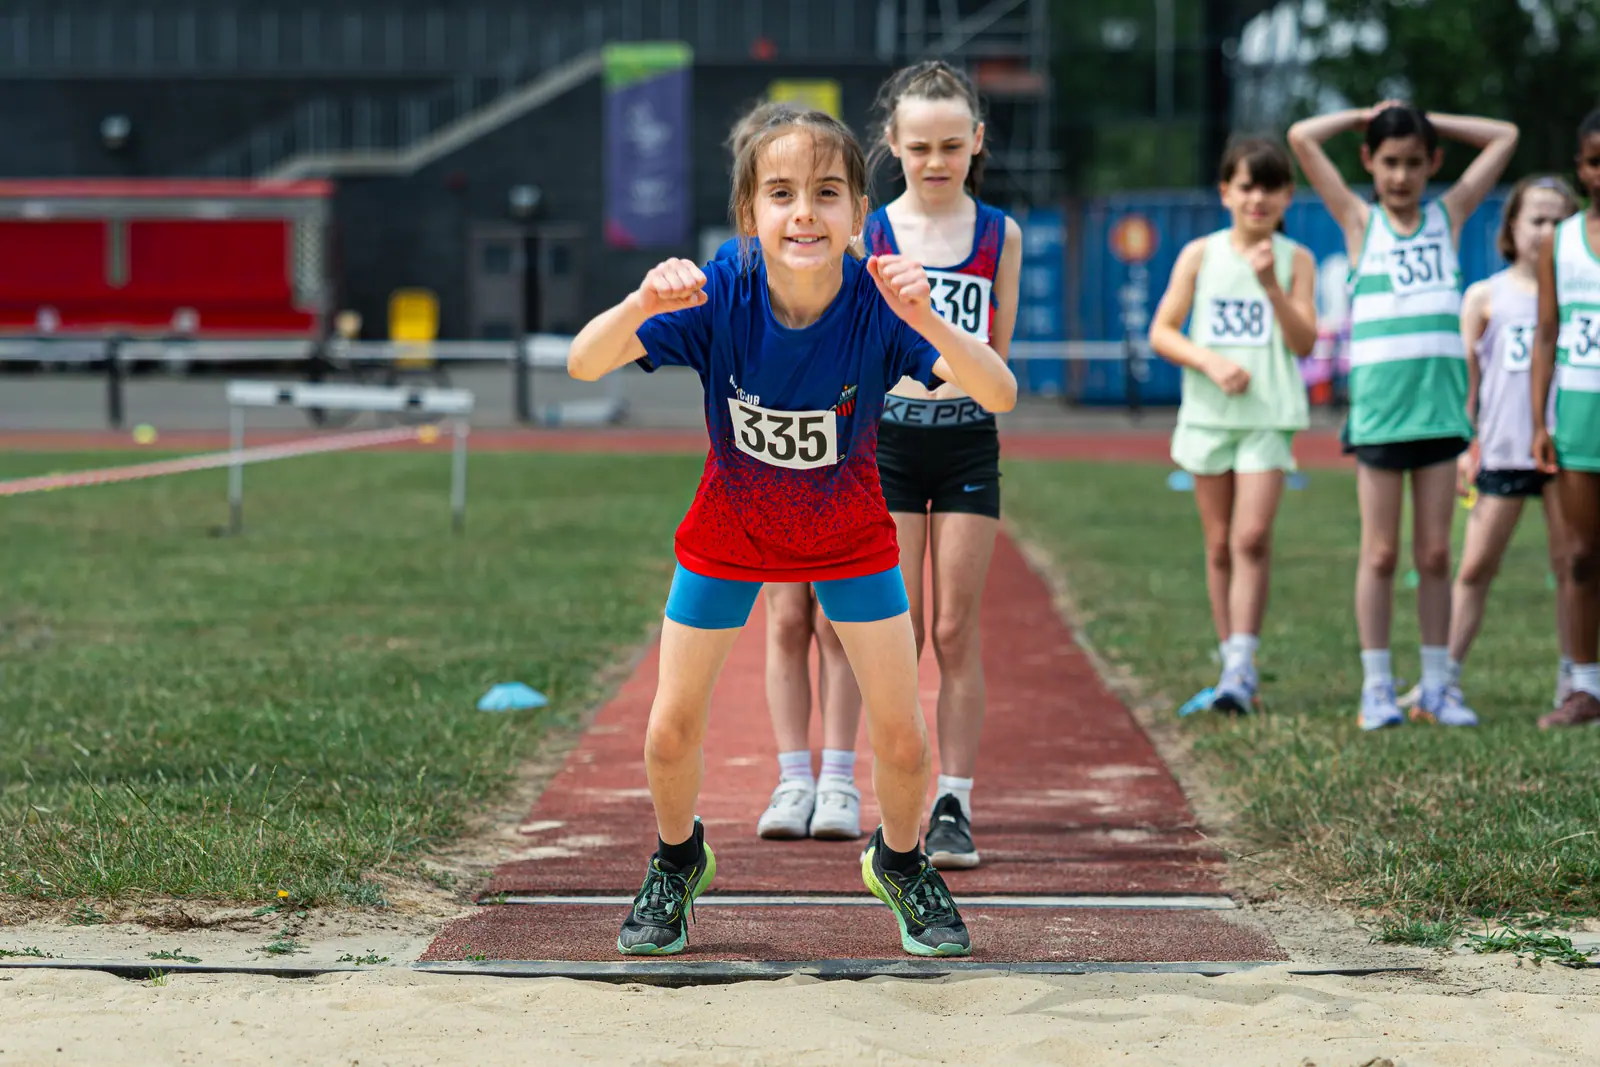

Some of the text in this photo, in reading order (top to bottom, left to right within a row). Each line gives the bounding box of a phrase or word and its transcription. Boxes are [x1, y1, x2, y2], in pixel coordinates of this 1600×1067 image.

[1390, 243, 1444, 285] 337
[1212, 299, 1263, 337] 338
[1510, 325, 1535, 362] 3
[739, 404, 827, 462] 335
